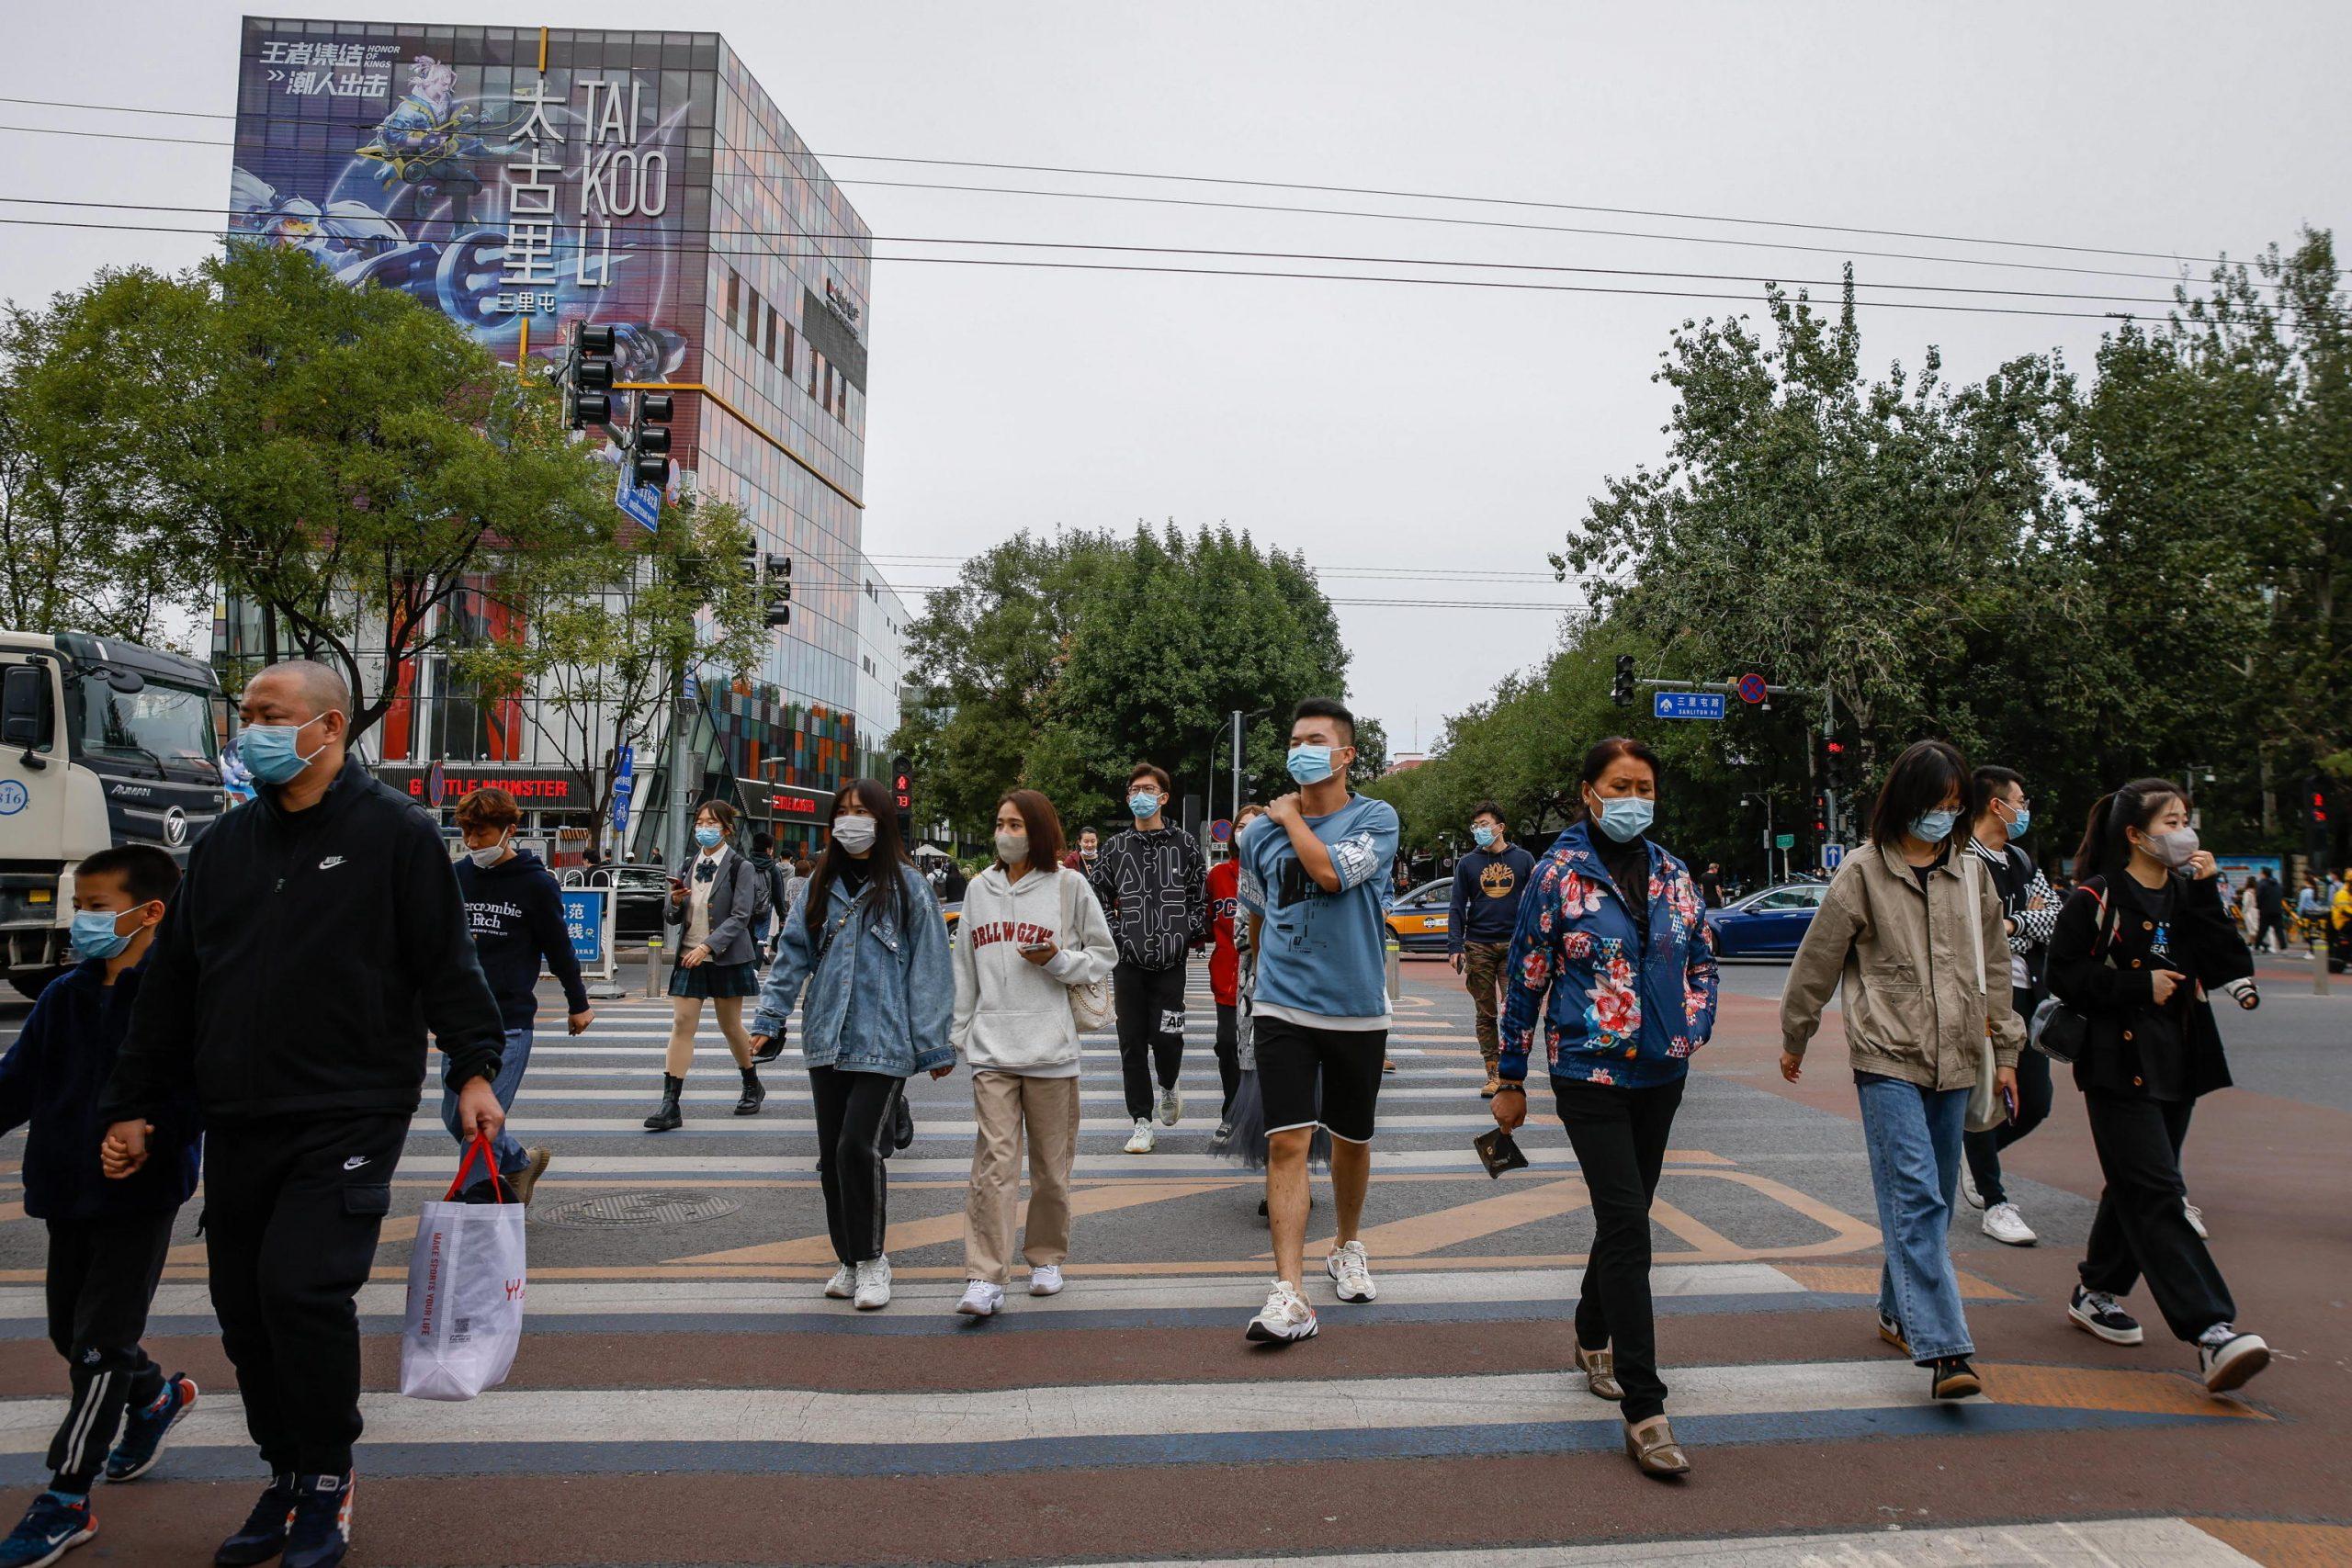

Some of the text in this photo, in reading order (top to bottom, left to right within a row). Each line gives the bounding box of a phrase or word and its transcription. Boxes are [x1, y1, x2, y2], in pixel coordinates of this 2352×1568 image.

[259, 41, 365, 67] 王者集结
[366, 52, 378, 61] OF
[368, 45, 401, 54] HONOR
[364, 60, 391, 68] KINGS
[285, 70, 389, 97] 潮人出击
[578, 80, 640, 147] TAI
[499, 79, 566, 286] 太古里
[580, 149, 669, 218] KOO
[576, 220, 612, 287] LI
[495, 291, 556, 313] 三里屯
[1677, 696, 1719, 707] 三里屯路
[111, 784, 152, 796] AUMAN
[410, 778, 479, 795] GTLE
[897, 795, 908, 807] 73
[464, 901, 522, 918] ercrombie
[562, 902, 584, 919] 范
[421, 1232, 442, 1337] MAKE SPORTS YOUR LIFE
